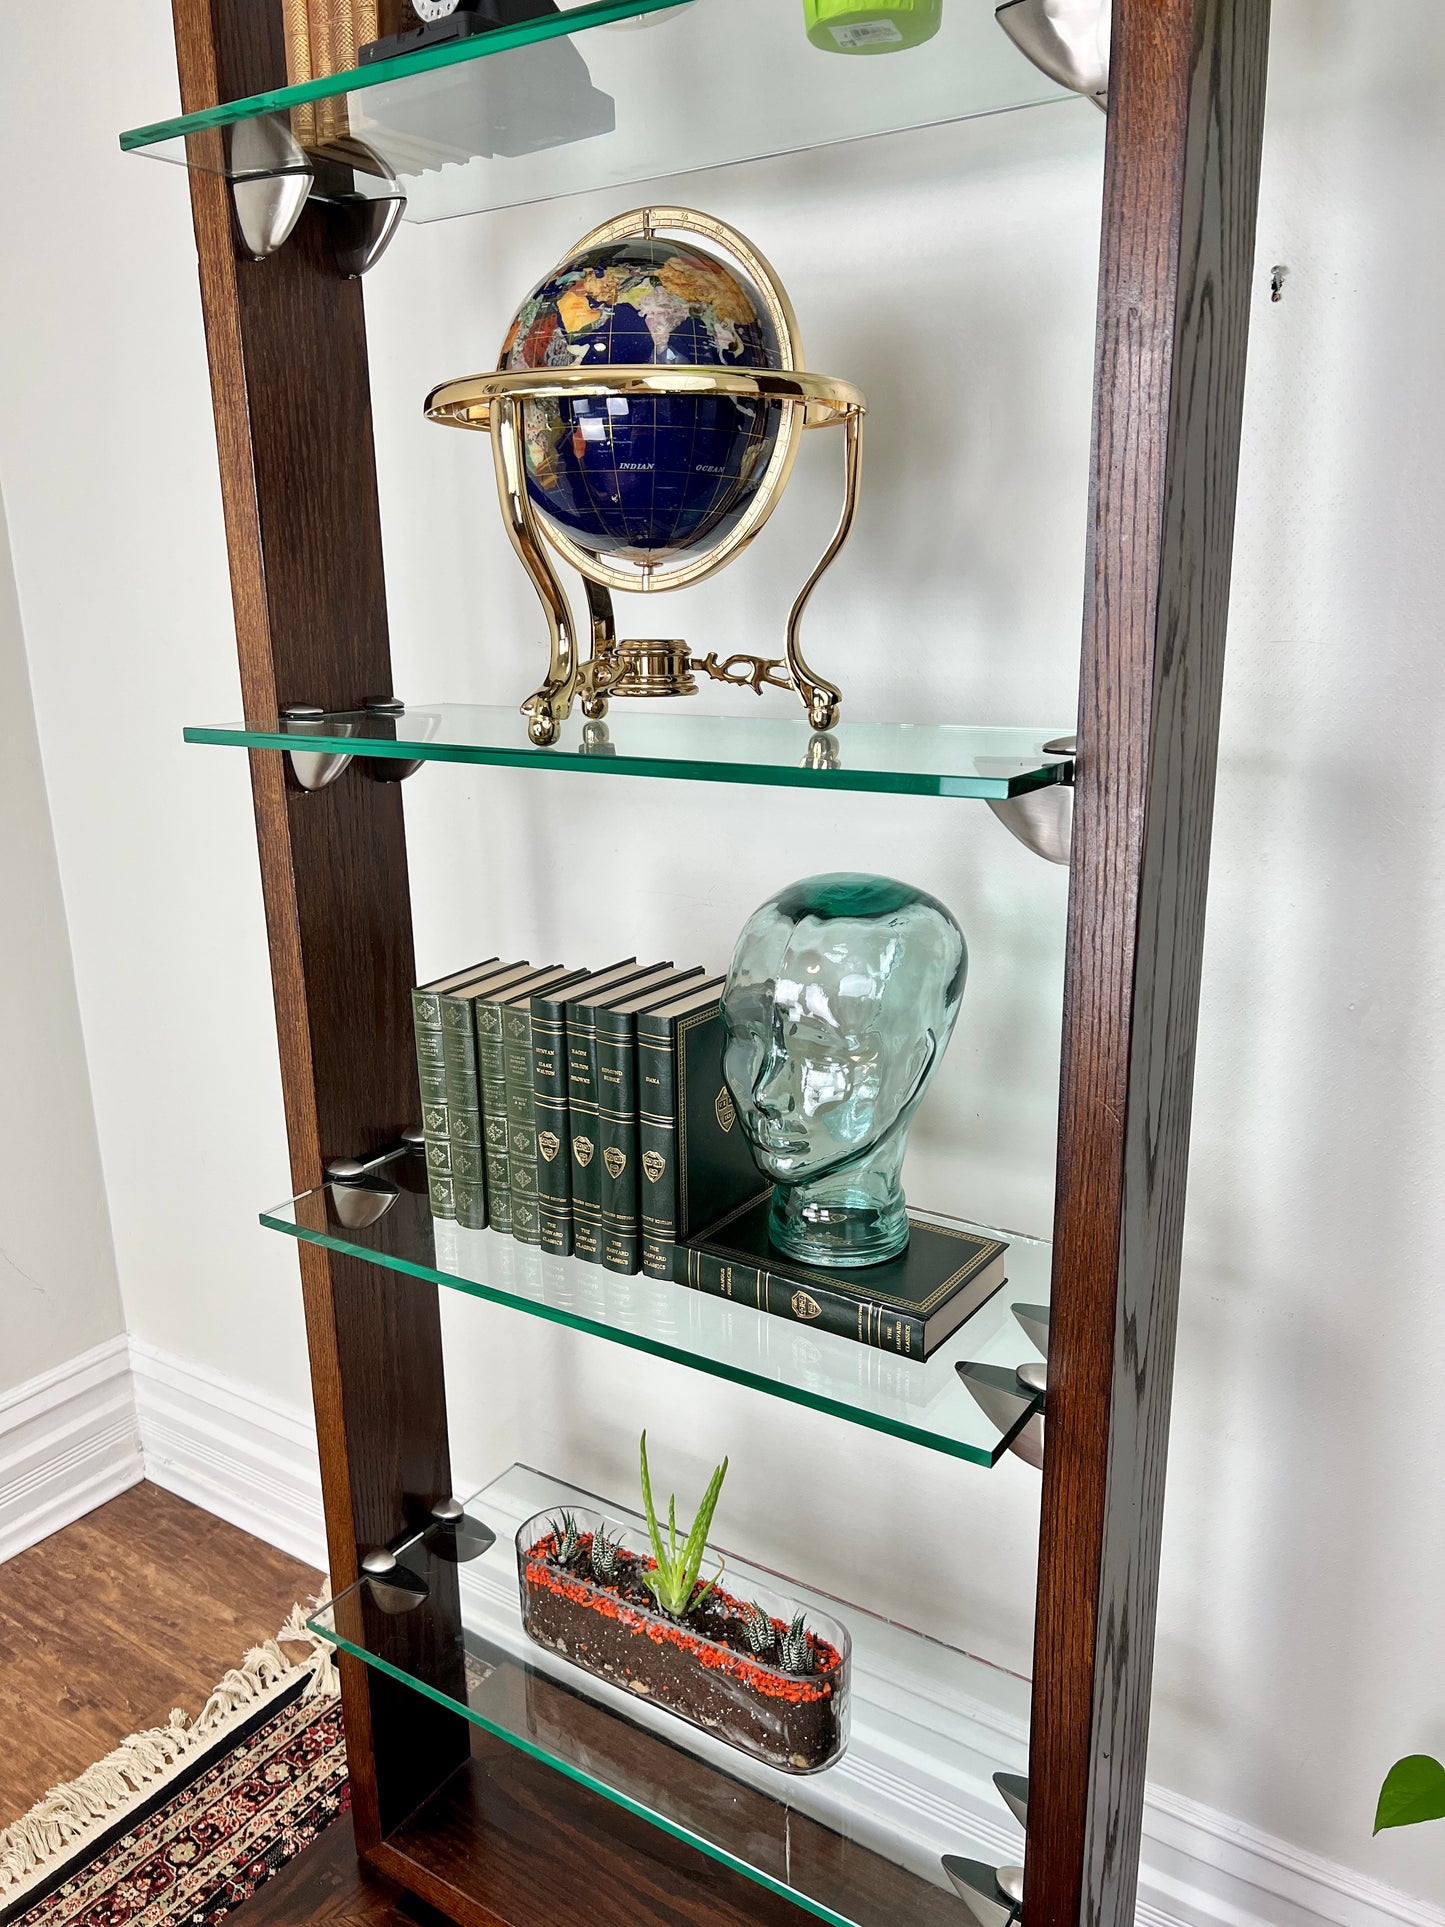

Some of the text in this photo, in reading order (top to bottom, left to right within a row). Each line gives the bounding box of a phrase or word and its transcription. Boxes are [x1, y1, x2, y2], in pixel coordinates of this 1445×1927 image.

[619, 462, 726, 473] INDIAN OCEAN
[571, 1062, 589, 1070] MILTON
[536, 1067, 556, 1076] WALTON
[601, 1067, 623, 1076] EDMUND
[570, 1075, 591, 1084] BROWNE
[603, 1074, 621, 1084] BURKE
[547, 1221, 557, 1229] THE
[541, 1227, 564, 1238] HARVARD
[581, 1227, 591, 1235] THE
[542, 1236, 563, 1246] CLASSICS
[575, 1233, 598, 1245] HARVARD
[611, 1240, 622, 1248] THE
[575, 1242, 597, 1253] CLASSICS
[606, 1246, 629, 1257] HARVARD
[649, 1244, 660, 1253] THE
[606, 1255, 629, 1266] CLASSICS
[643, 1250, 667, 1262] HARVARD
[643, 1259, 667, 1270] CLASSICS
